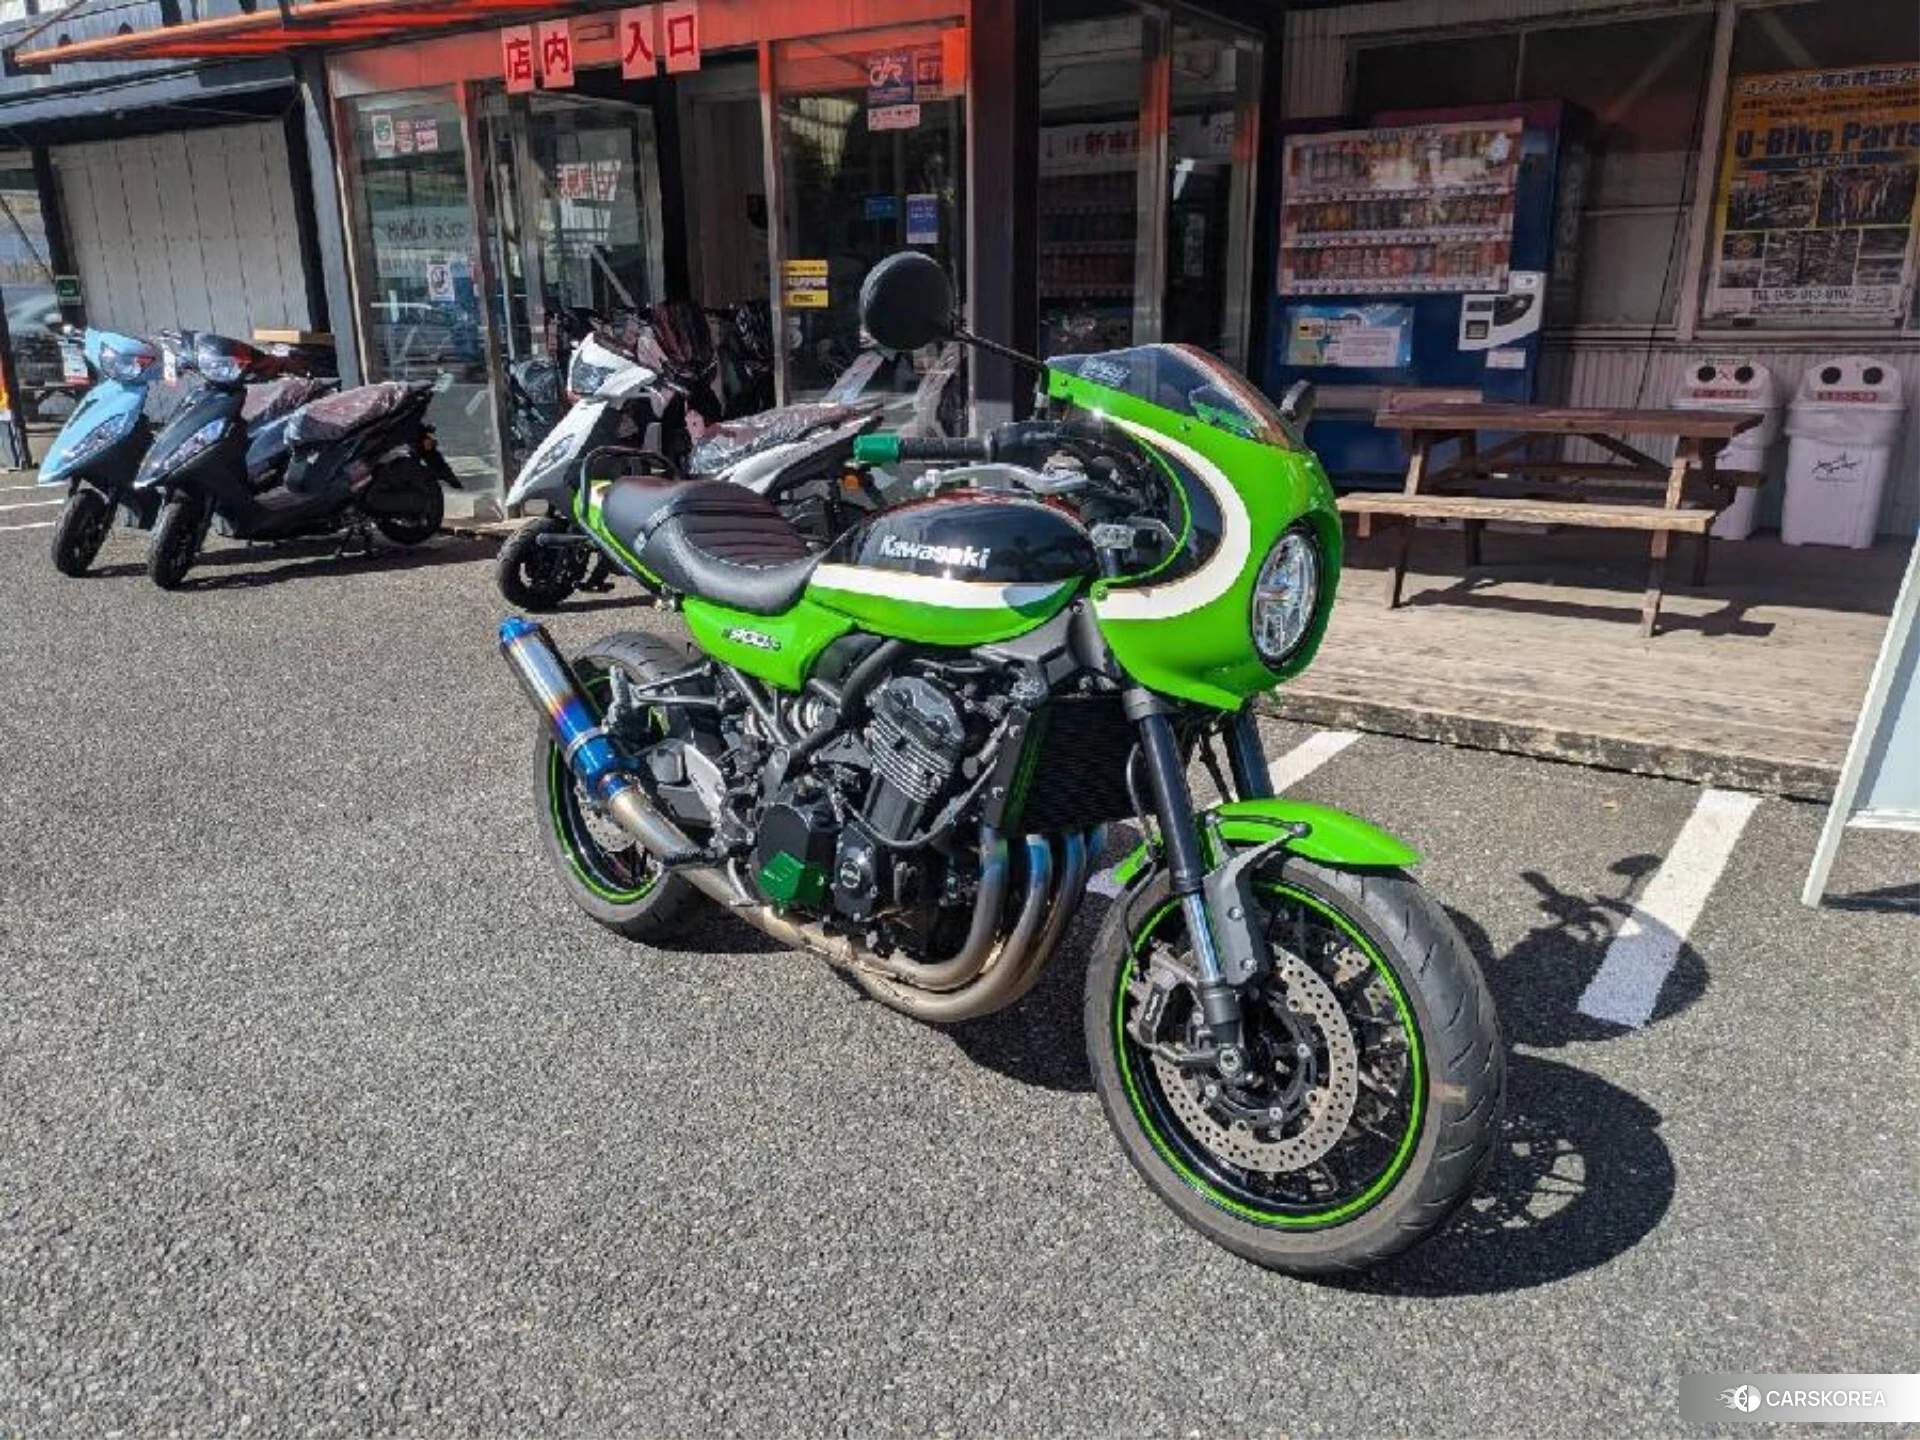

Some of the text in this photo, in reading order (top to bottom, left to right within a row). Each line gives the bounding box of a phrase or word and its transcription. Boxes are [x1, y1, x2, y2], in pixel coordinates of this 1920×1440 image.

[505, 15, 695, 83] 店内 入口
[1736, 121, 1920, 158] U-Bike Parts
[879, 534, 991, 571] Kawasaki
